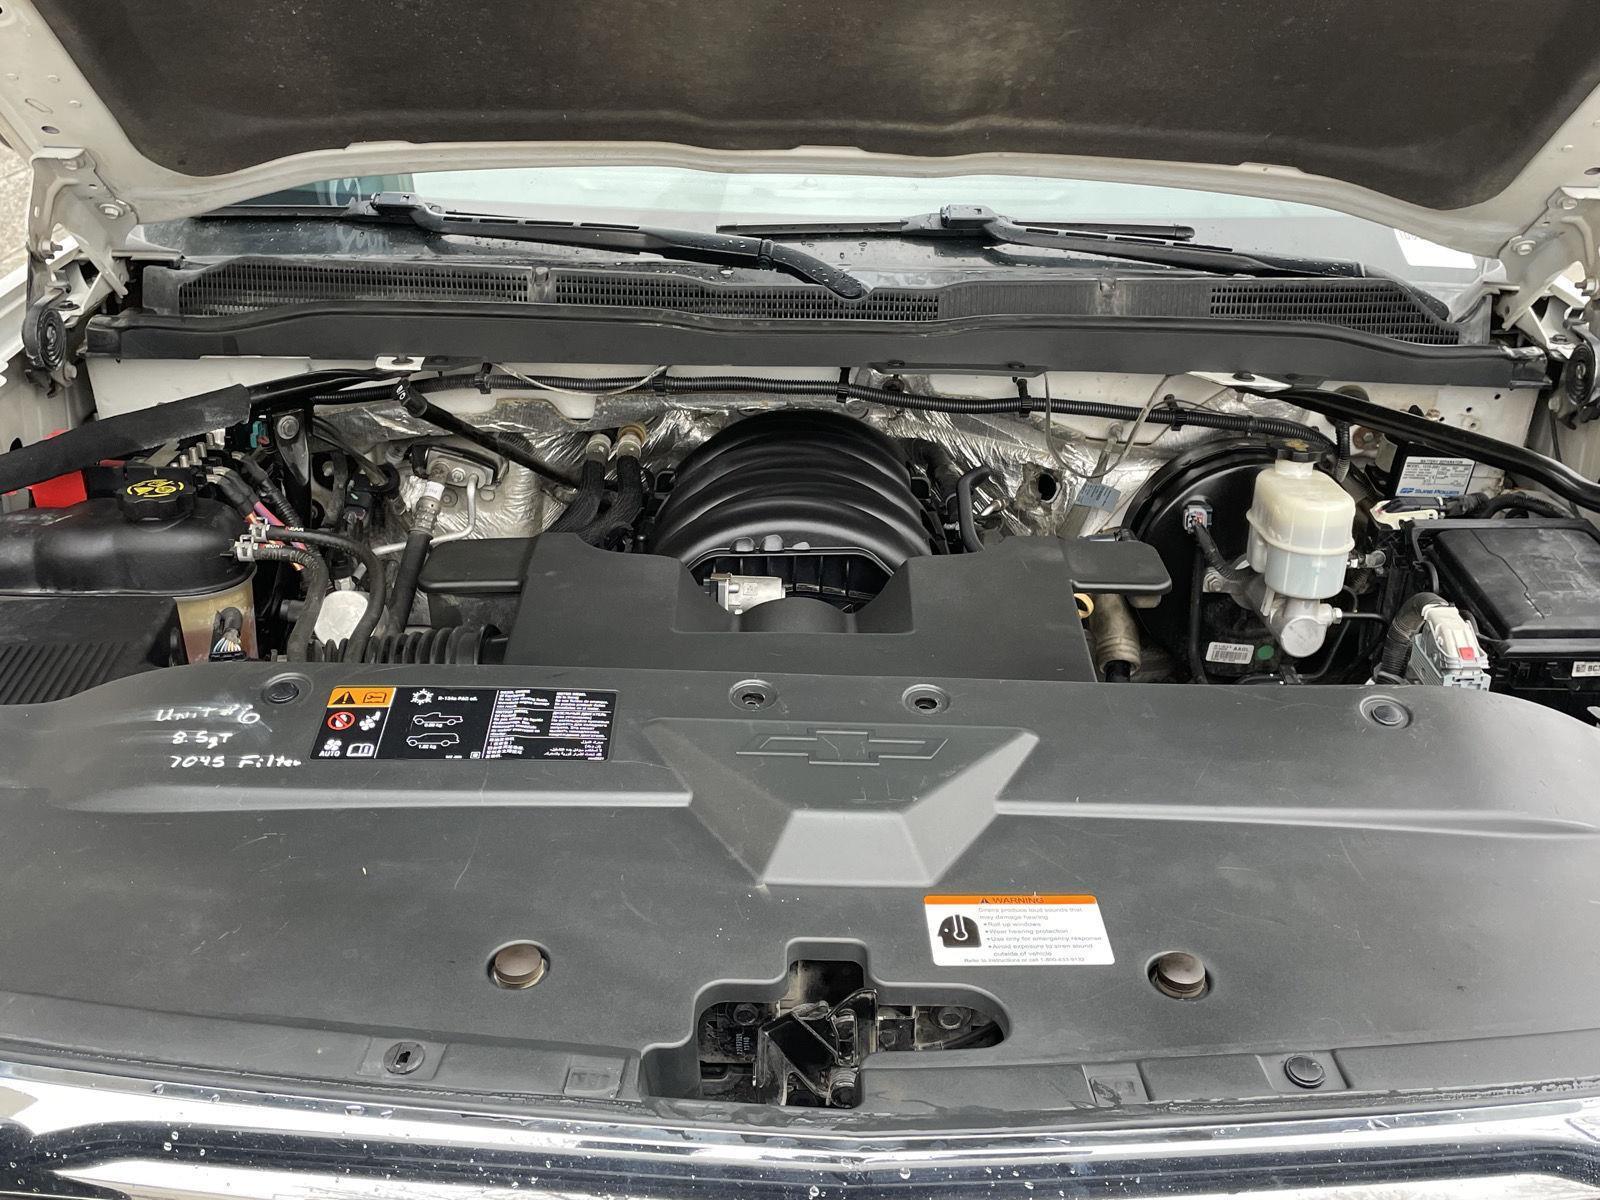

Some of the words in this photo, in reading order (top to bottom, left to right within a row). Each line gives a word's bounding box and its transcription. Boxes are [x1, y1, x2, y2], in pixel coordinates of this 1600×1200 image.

[319, 749, 341, 757] AUTO
[170, 755, 225, 768] 7045
[992, 896, 1045, 904] WARNING
